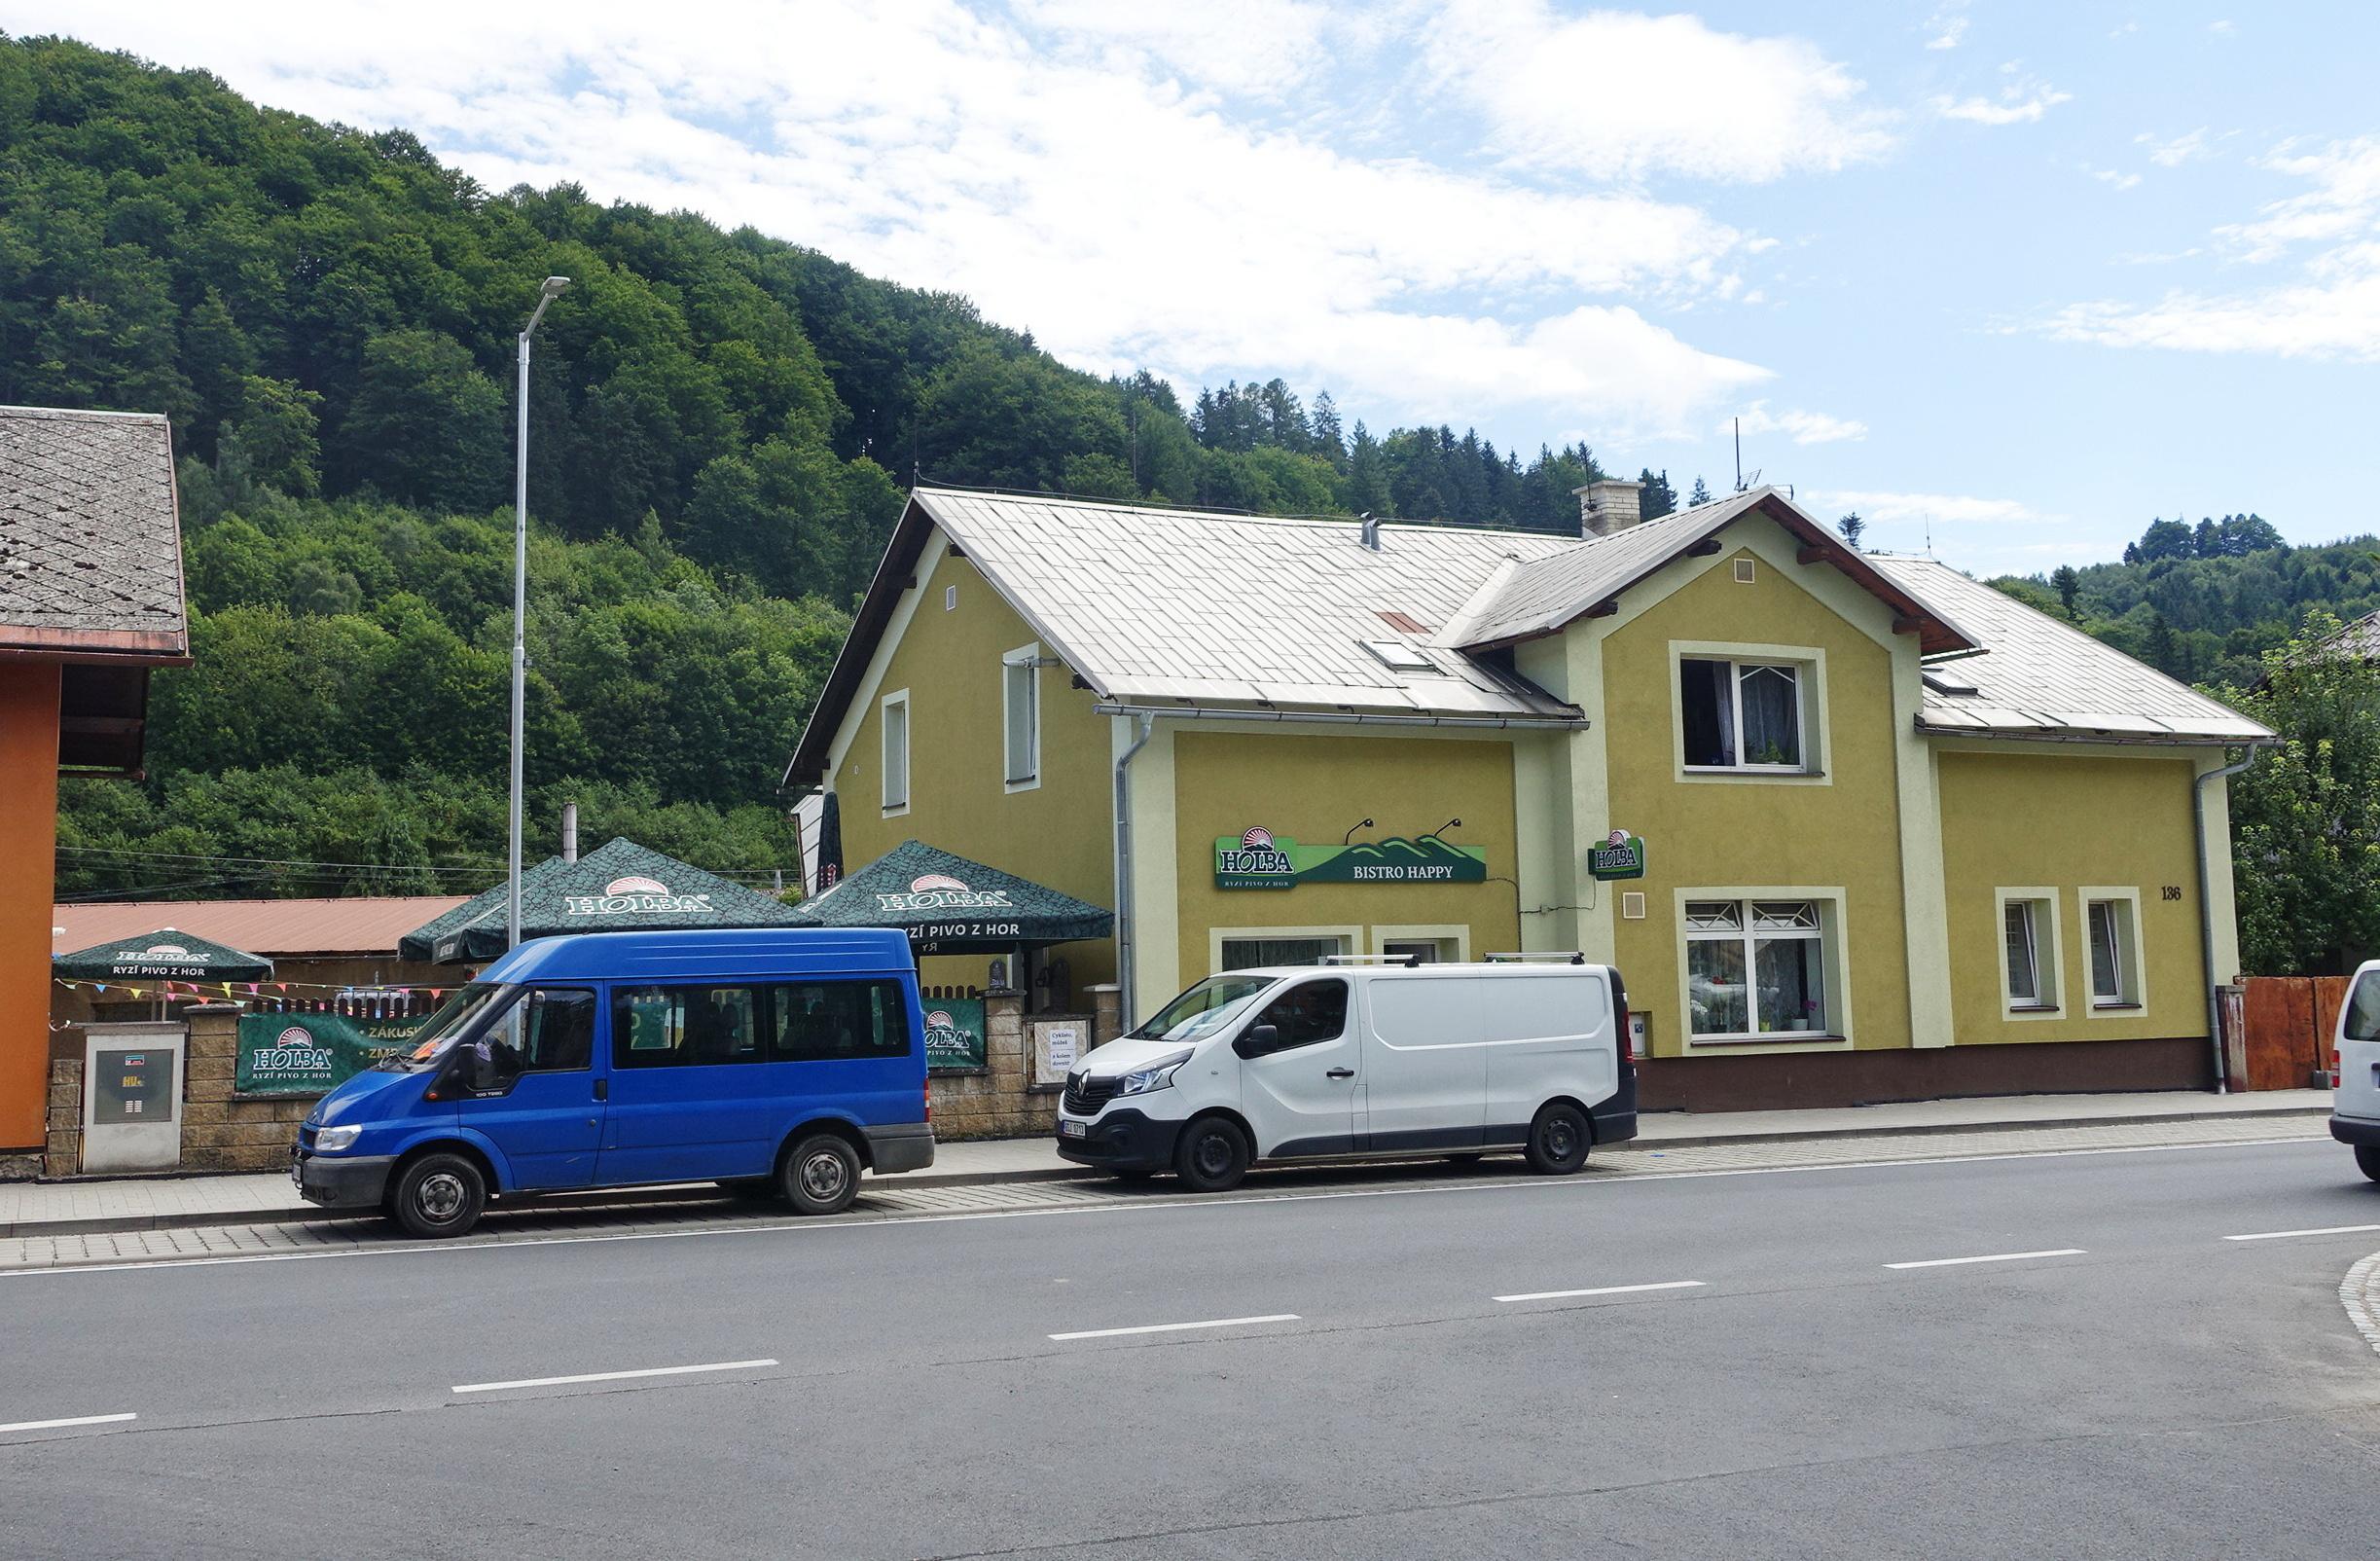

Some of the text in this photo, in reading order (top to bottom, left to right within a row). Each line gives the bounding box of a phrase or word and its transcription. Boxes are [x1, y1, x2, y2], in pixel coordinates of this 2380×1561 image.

[1220, 850, 1295, 873] HOLBA
[1596, 847, 1638, 868] HOLBA
[1353, 866, 1453, 879] BISTRO HAPPY
[877, 890, 1013, 911] HOLBA
[2161, 886, 2182, 901] 136
[565, 893, 713, 915] HOLBA
[929, 925, 966, 937] PIVO
[971, 925, 981, 935] Z
[986, 925, 1020, 935] HOR
[113, 964, 138, 974] RYZÍ
[142, 966, 167, 975] PIVO
[924, 1030, 969, 1048] OLBA
[253, 1049, 332, 1071] HOLBA
